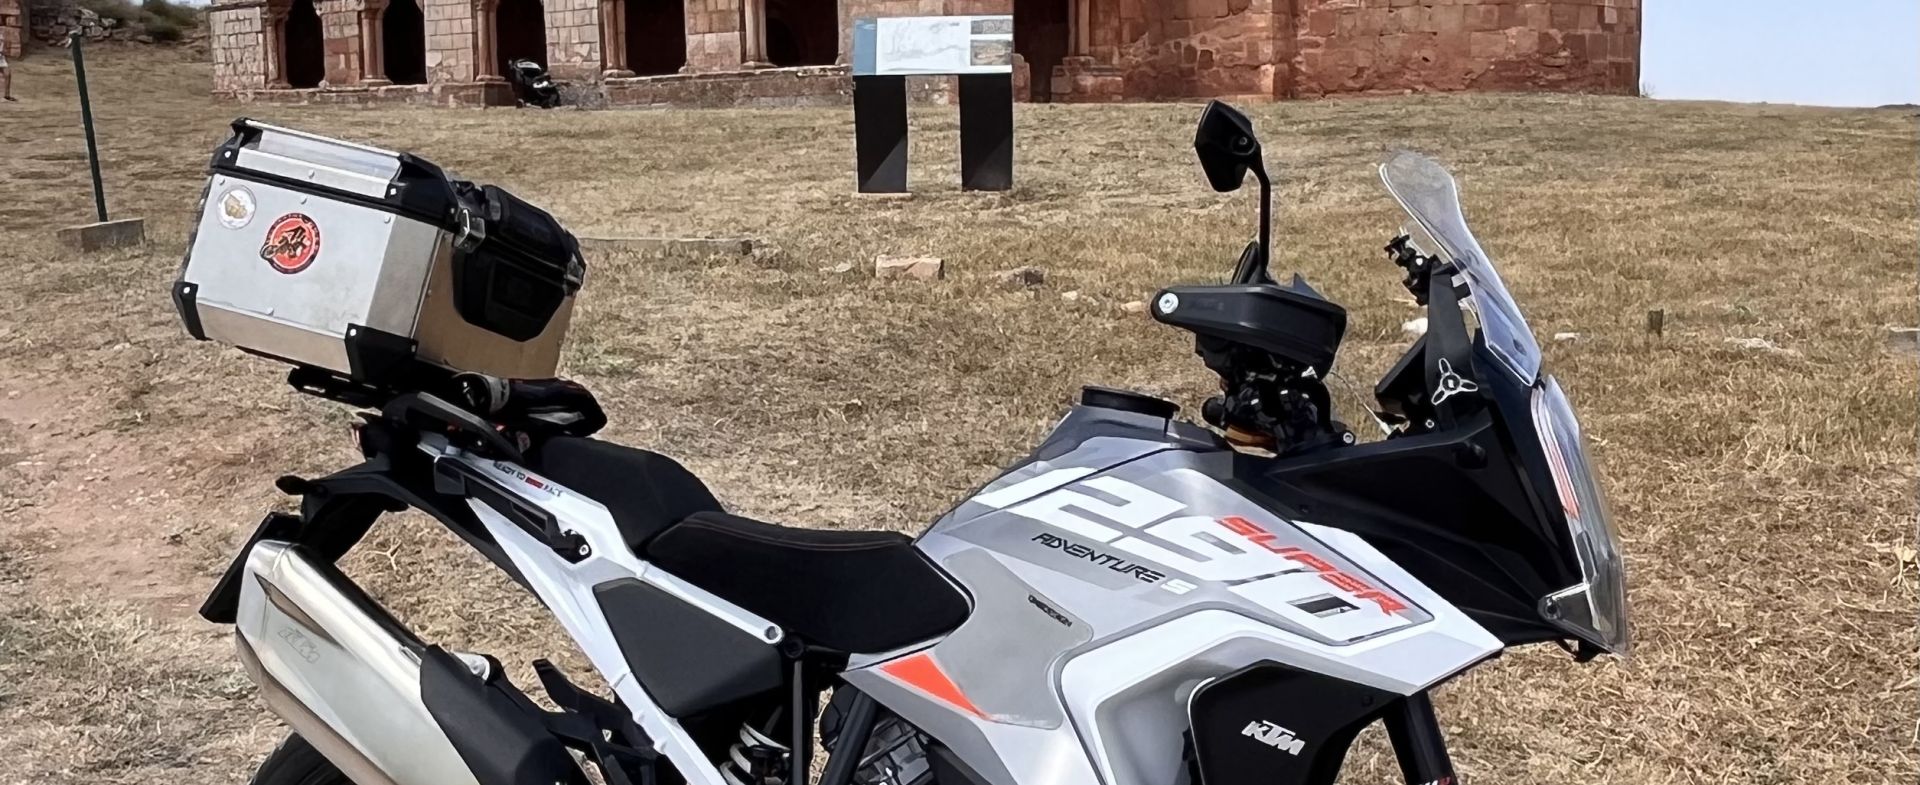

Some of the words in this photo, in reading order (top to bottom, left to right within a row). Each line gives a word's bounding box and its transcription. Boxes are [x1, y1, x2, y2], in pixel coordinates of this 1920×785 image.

[1032, 533, 1165, 583] ADVENTURE
[1160, 579, 1198, 595] S
[1215, 516, 1408, 616] SUPER
[1241, 720, 1305, 756] KTM
